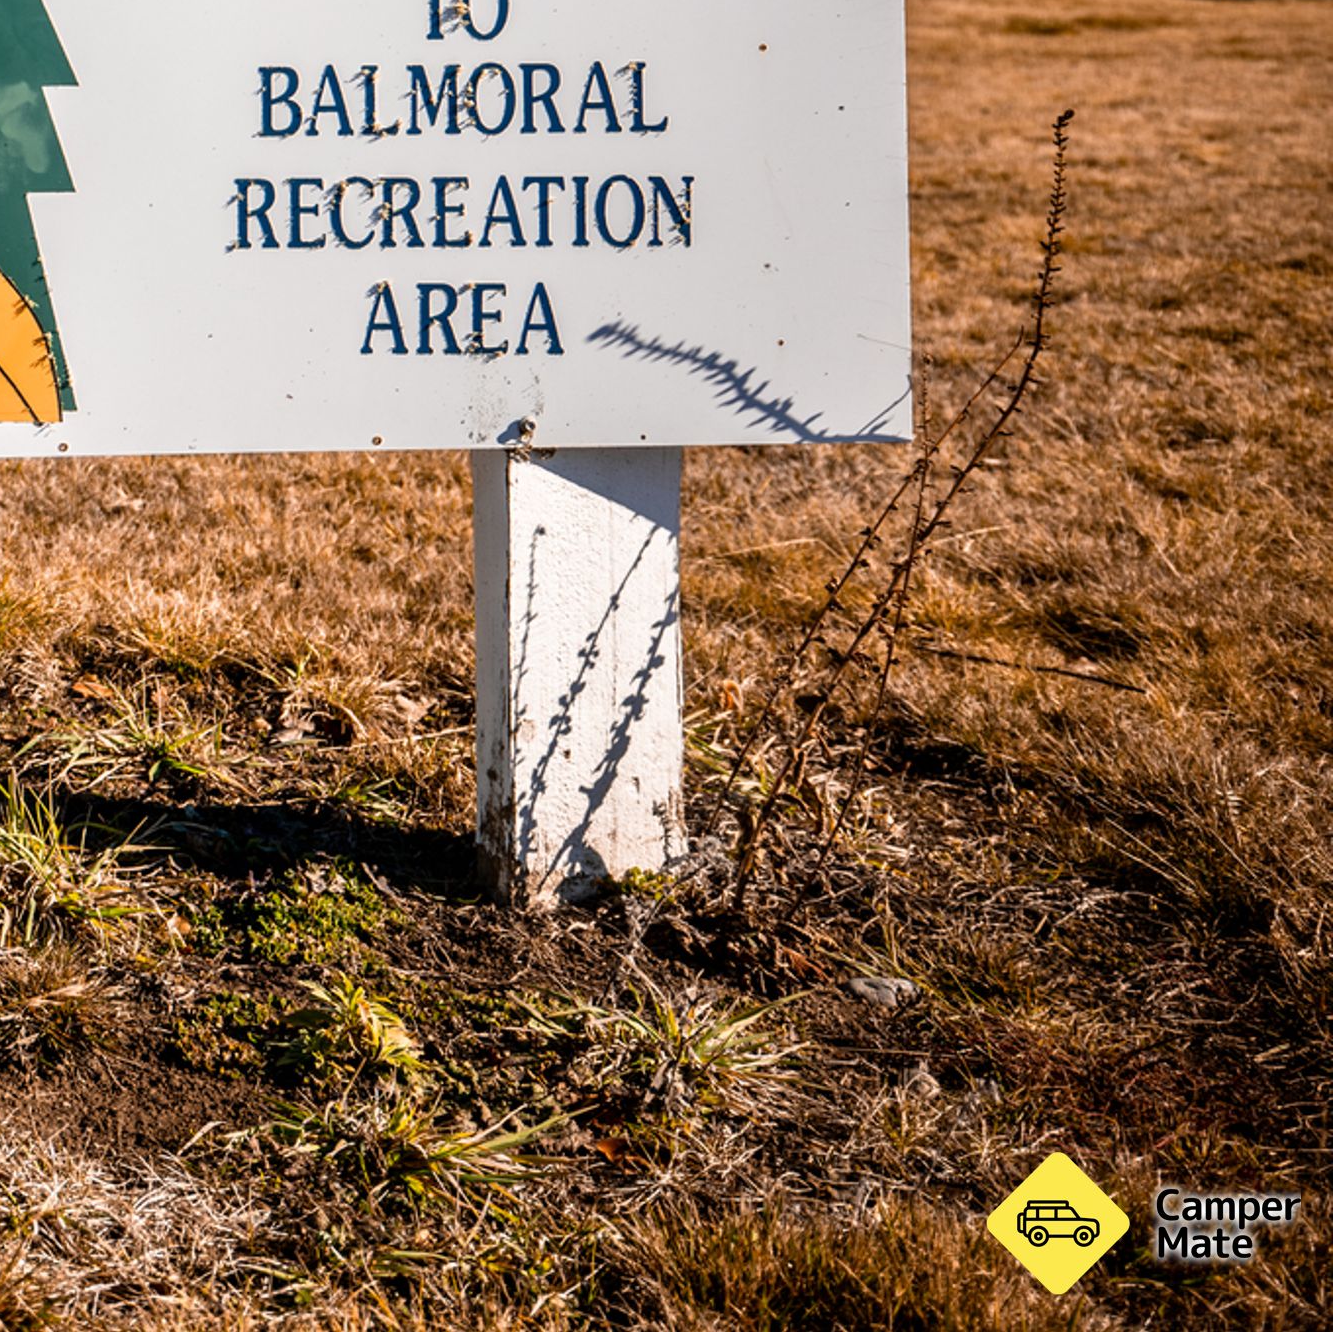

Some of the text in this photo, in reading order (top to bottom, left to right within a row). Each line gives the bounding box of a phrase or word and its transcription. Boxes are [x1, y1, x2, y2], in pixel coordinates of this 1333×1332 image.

[258, 62, 668, 137] BALMORAL
[234, 175, 694, 249] RECREATION
[361, 283, 562, 354] AREA
